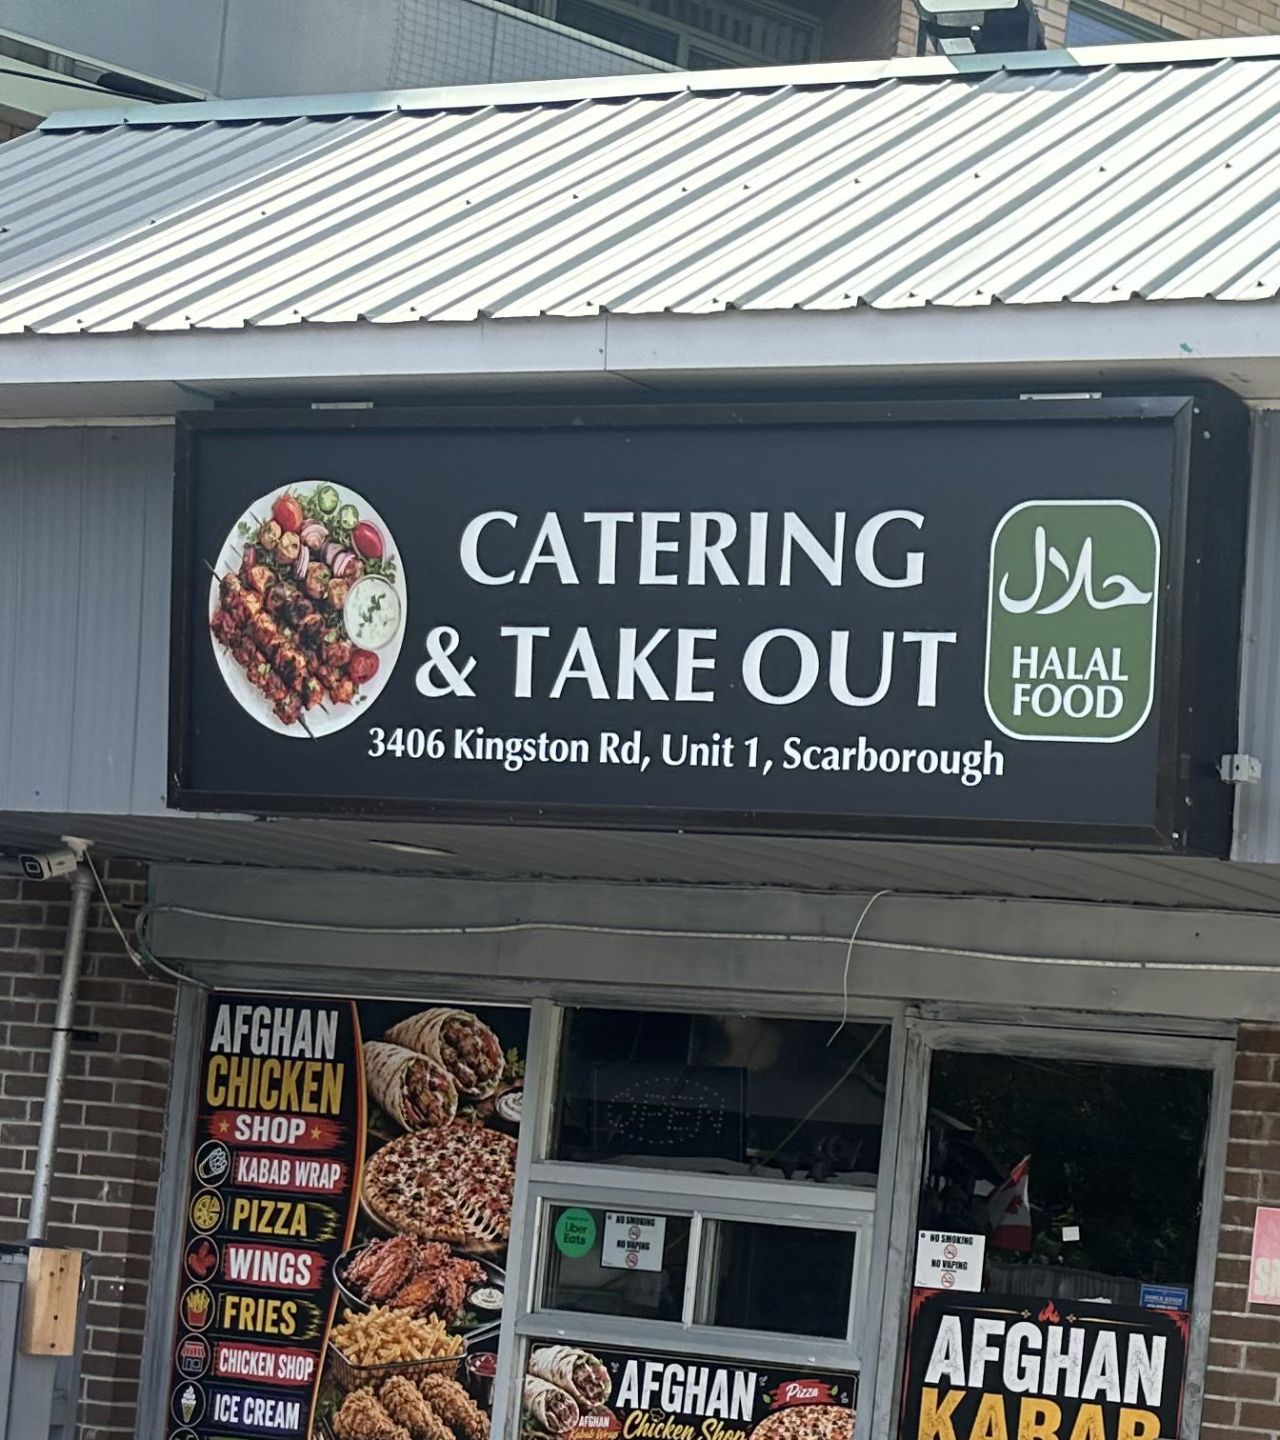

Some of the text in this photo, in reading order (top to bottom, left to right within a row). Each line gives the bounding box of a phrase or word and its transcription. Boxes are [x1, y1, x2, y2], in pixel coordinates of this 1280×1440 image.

[459, 510, 927, 590] CATERING
[999, 525, 1154, 615] حلال
[413, 626, 958, 709] & TAKE OUT
[1011, 645, 1129, 682] HALAL
[1011, 684, 1124, 720] FOOD
[367, 725, 1006, 787] 3406 Kingston Rd, Unit 1, Scarborough
[210, 1004, 339, 1060] AFGHAN
[206, 1055, 345, 1116] CHICKEN
[234, 1113, 307, 1145] SHOP
[236, 1155, 342, 1190] KABAB WRAP
[231, 1198, 308, 1237] PIZZA
[564, 1221, 588, 1234] Uber
[563, 1232, 587, 1246] Eats
[930, 1233, 974, 1246] NO SMOKING
[228, 1247, 312, 1287] WINGS
[931, 1259, 941, 1268] NO
[222, 1295, 298, 1336] FRIES
[219, 1348, 314, 1382] CHICKEN SHOP
[923, 1314, 1168, 1408] AFGHAN
[615, 1359, 758, 1422] AFGHAN
[785, 1383, 819, 1401] Pizza
[214, 1393, 301, 1431] ICE CREAM
[579, 1415, 610, 1429] AFGHAN
